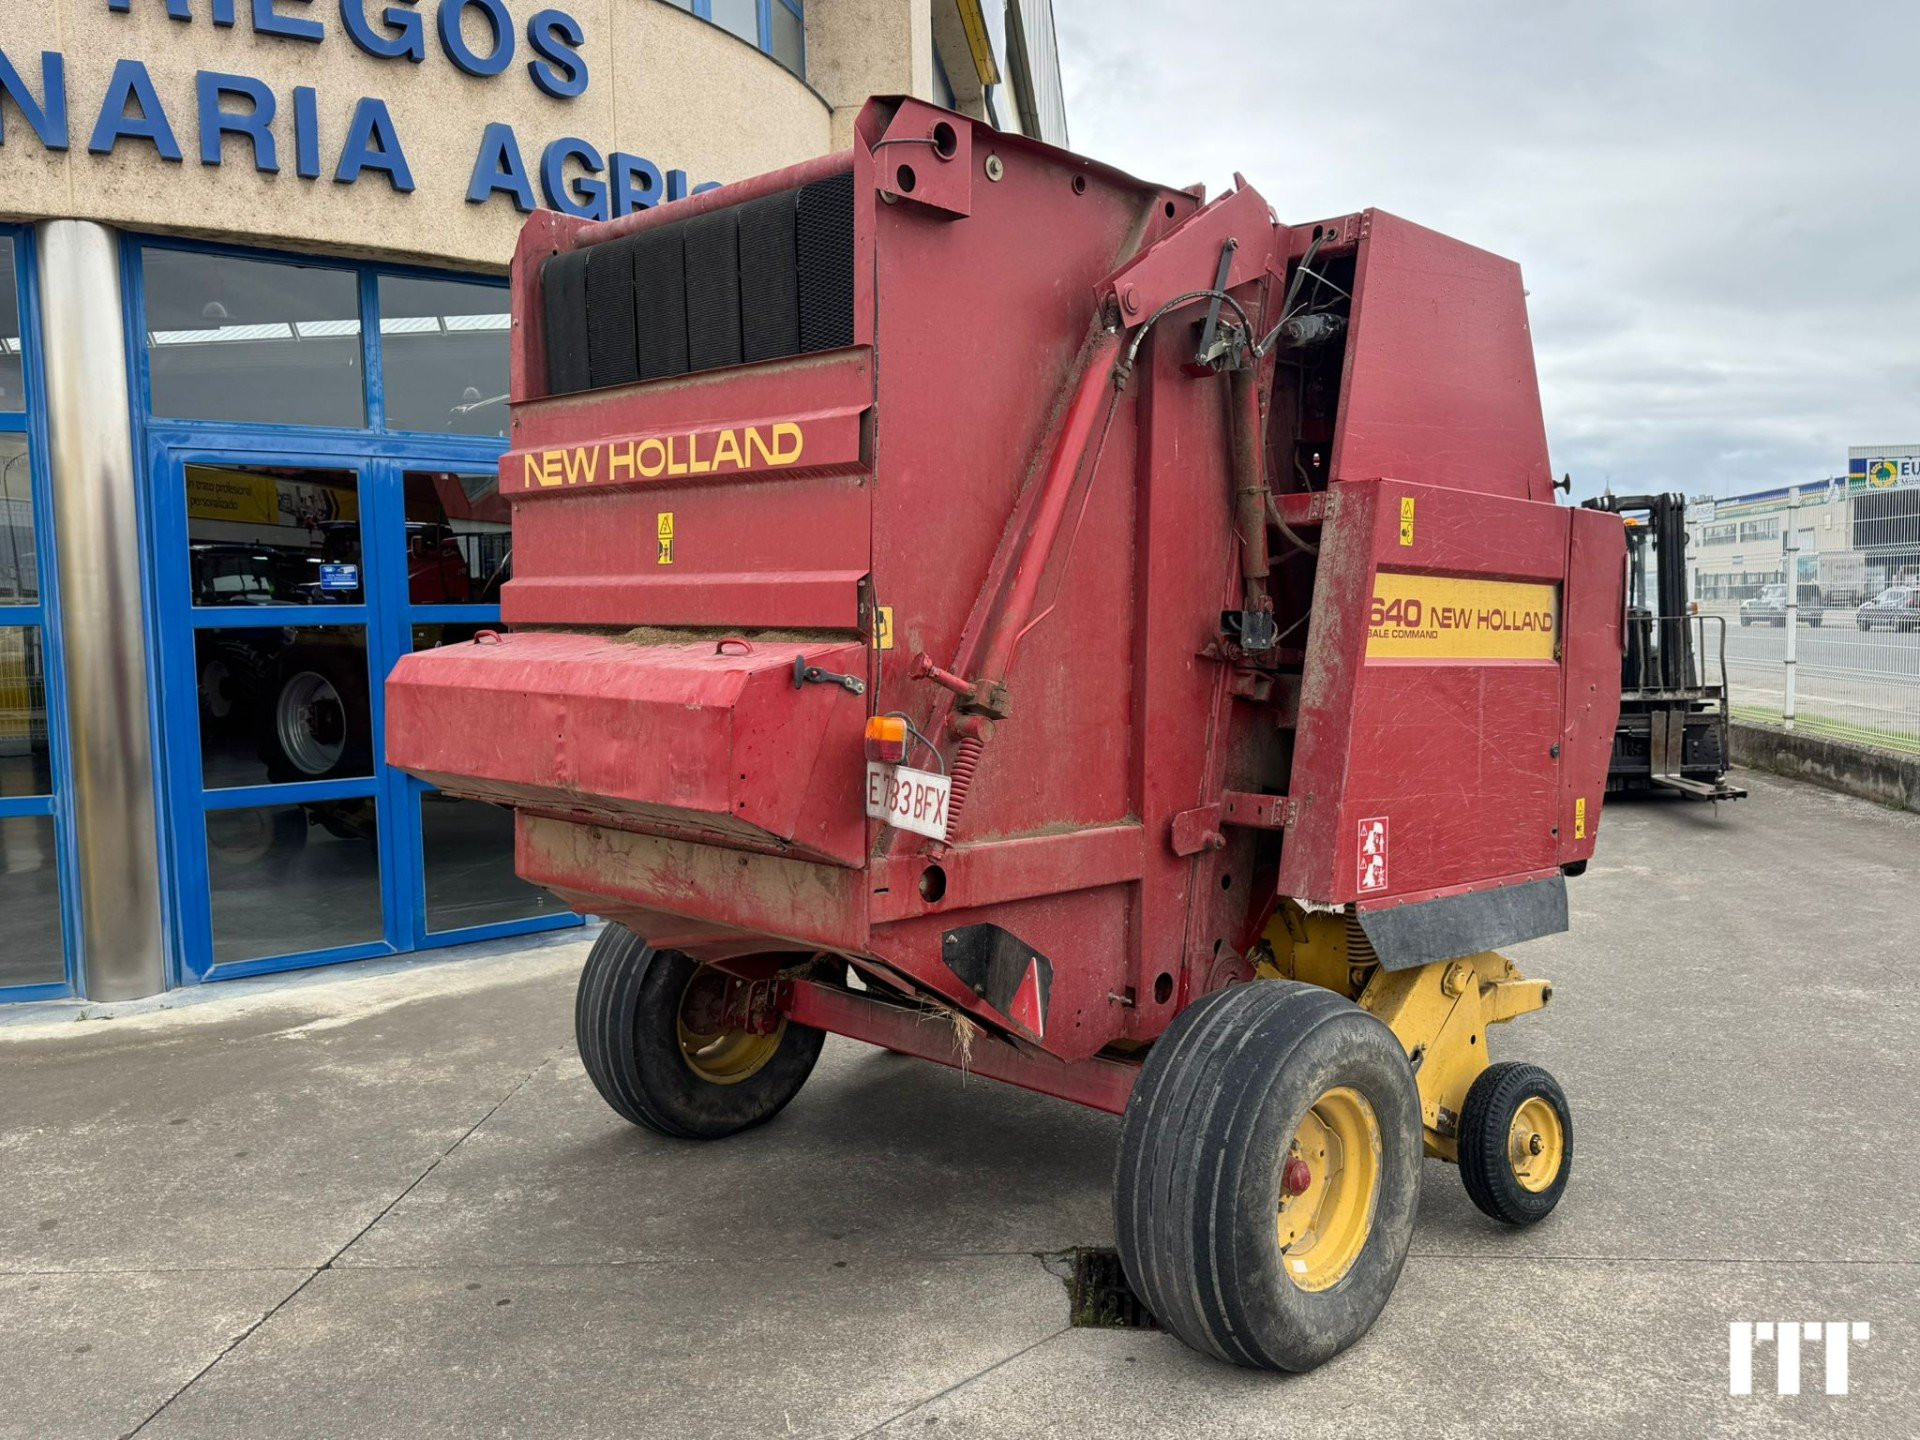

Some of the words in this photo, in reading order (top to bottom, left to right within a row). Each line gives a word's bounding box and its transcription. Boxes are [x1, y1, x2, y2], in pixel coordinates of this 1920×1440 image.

[466, 121, 723, 222] AGR
[524, 444, 600, 488] NEW
[608, 422, 803, 480] HOLLAND
[1368, 597, 1422, 628] 640
[1430, 606, 1473, 629] NEW
[1477, 608, 1553, 632] HOLLAND
[1391, 629, 1438, 639] COMMAND
[913, 782, 946, 826] BFX
